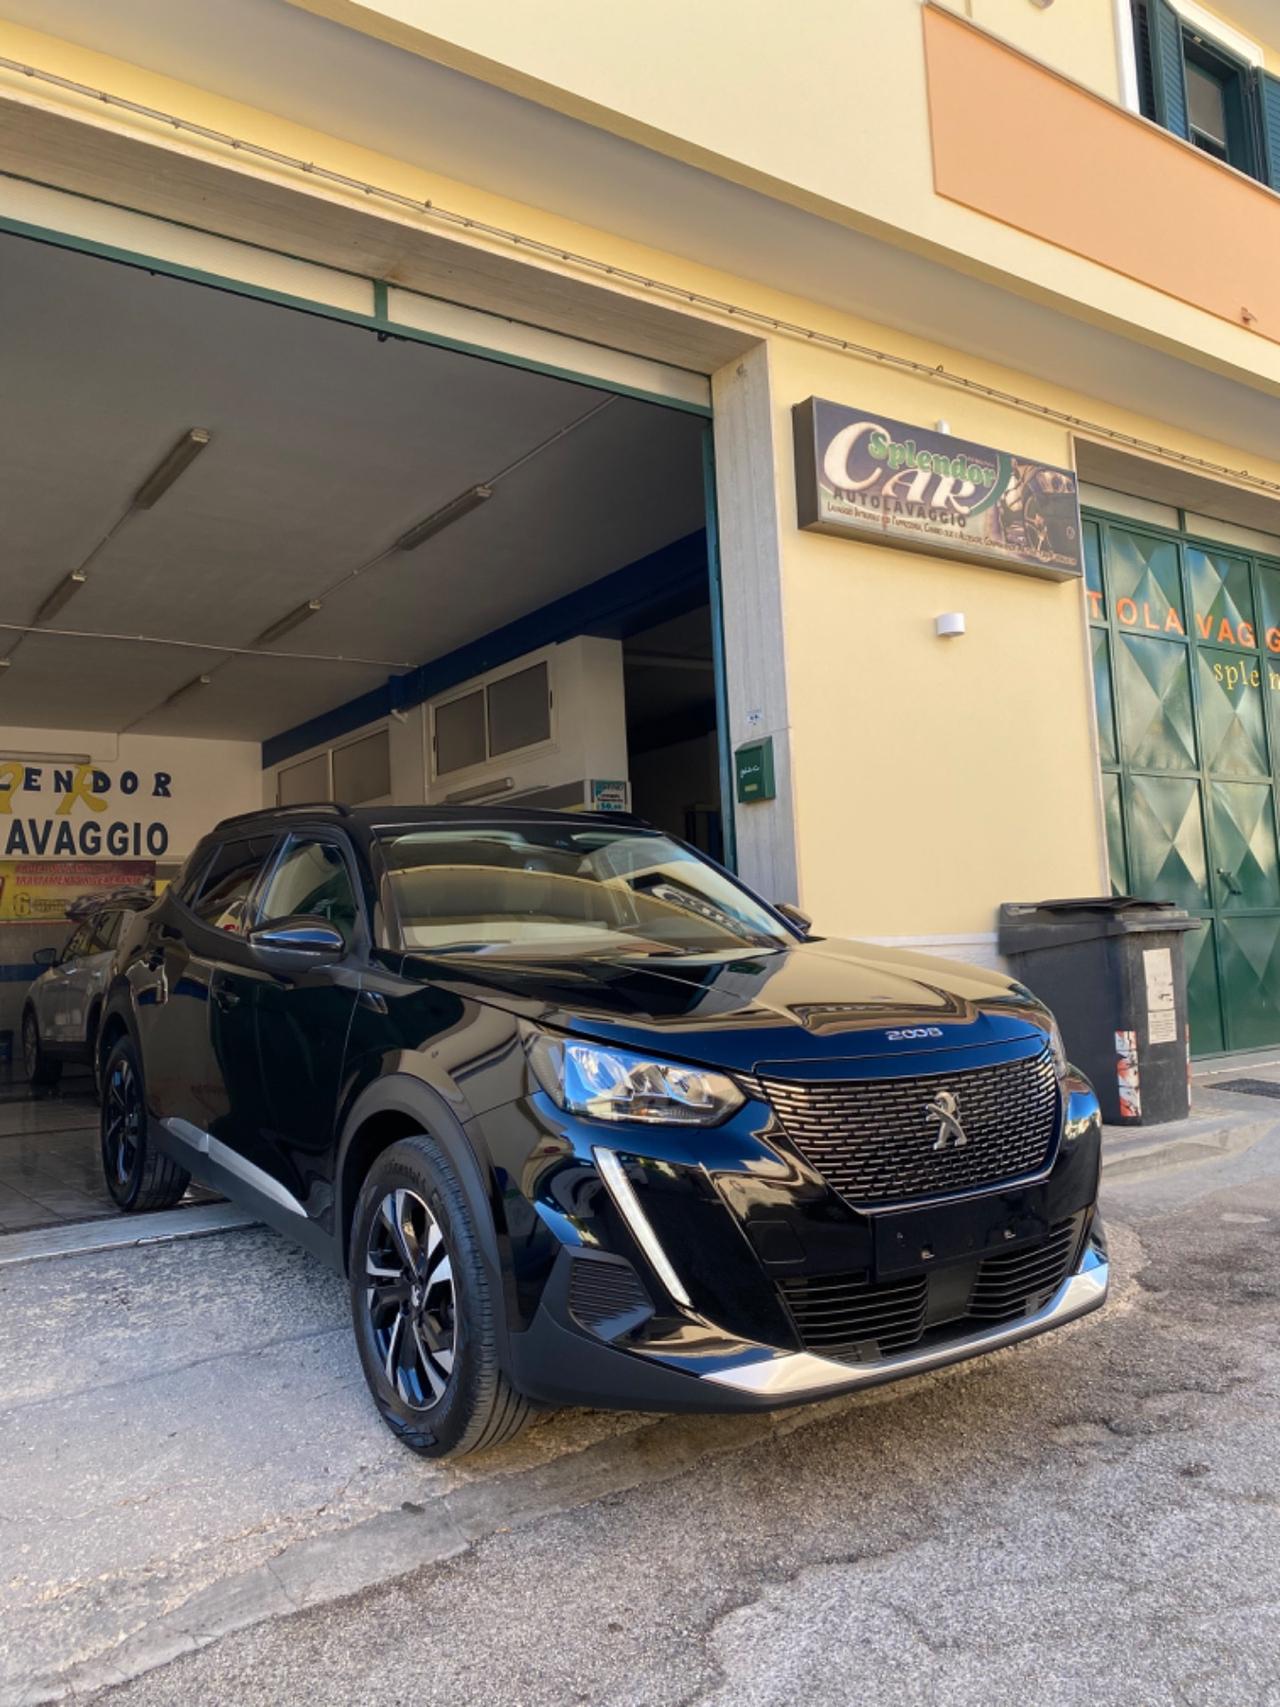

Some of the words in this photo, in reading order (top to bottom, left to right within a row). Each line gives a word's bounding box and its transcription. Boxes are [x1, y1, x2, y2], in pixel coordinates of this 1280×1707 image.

[868, 431, 997, 488] Splendor
[833, 488, 968, 528] AUTOLAVAGGIO
[0, 767, 172, 797] ENDOR
[885, 1027, 943, 1041] 2008
